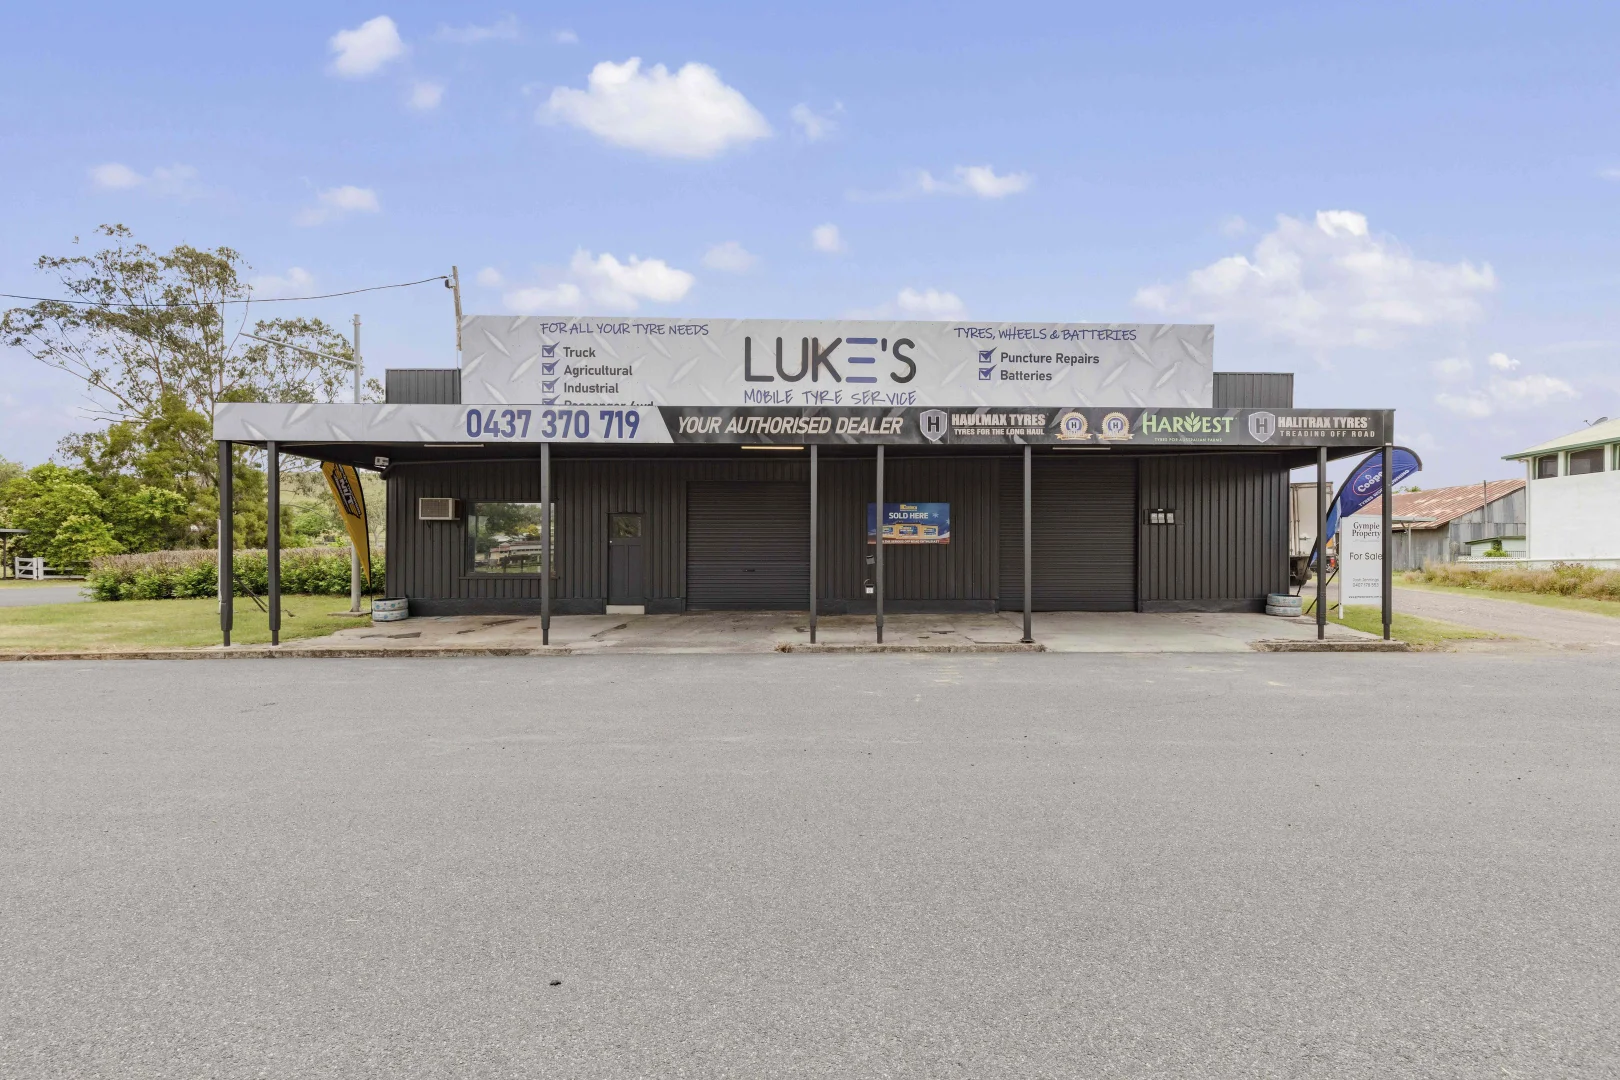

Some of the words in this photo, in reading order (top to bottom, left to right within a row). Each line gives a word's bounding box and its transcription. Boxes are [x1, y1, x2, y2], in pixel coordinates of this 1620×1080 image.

[540, 323, 567, 334] FOR
[569, 323, 594, 334] ALL
[596, 324, 630, 334] YOUR
[632, 324, 666, 335] TYRE
[668, 324, 709, 336] NEEDS
[954, 328, 996, 340] TYRES,
[998, 327, 1046, 340] WHEELS
[1050, 330, 1059, 339] &
[1061, 329, 1137, 340] BATTERIES
[563, 347, 596, 358] Truck
[744, 336, 917, 384] LUKE'S
[1000, 353, 1052, 364] Puncture
[1056, 353, 1099, 365] Repairs
[564, 365, 632, 377] Agricultural
[1000, 370, 1052, 381] Batteries
[564, 383, 619, 393] Industrial
[744, 388, 793, 404] MOBILE
[802, 390, 842, 405] TYRE
[851, 390, 916, 405] SERVICE
[466, 409, 532, 438] 0437
[541, 410, 590, 439] 370
[600, 410, 640, 439] 719
[678, 417, 722, 434] YOUR
[724, 417, 831, 434] AUTHORISED
[836, 417, 904, 434] DEALER
[952, 414, 1007, 425] HAULMAX
[1009, 414, 1045, 425] TYRES
[1143, 412, 1234, 435] HARVEST
[1278, 417, 1331, 428] HALITRAX
[1333, 417, 1367, 428] TYRES
[1353, 522, 1380, 531] Gympie
[1352, 530, 1381, 538] Property
